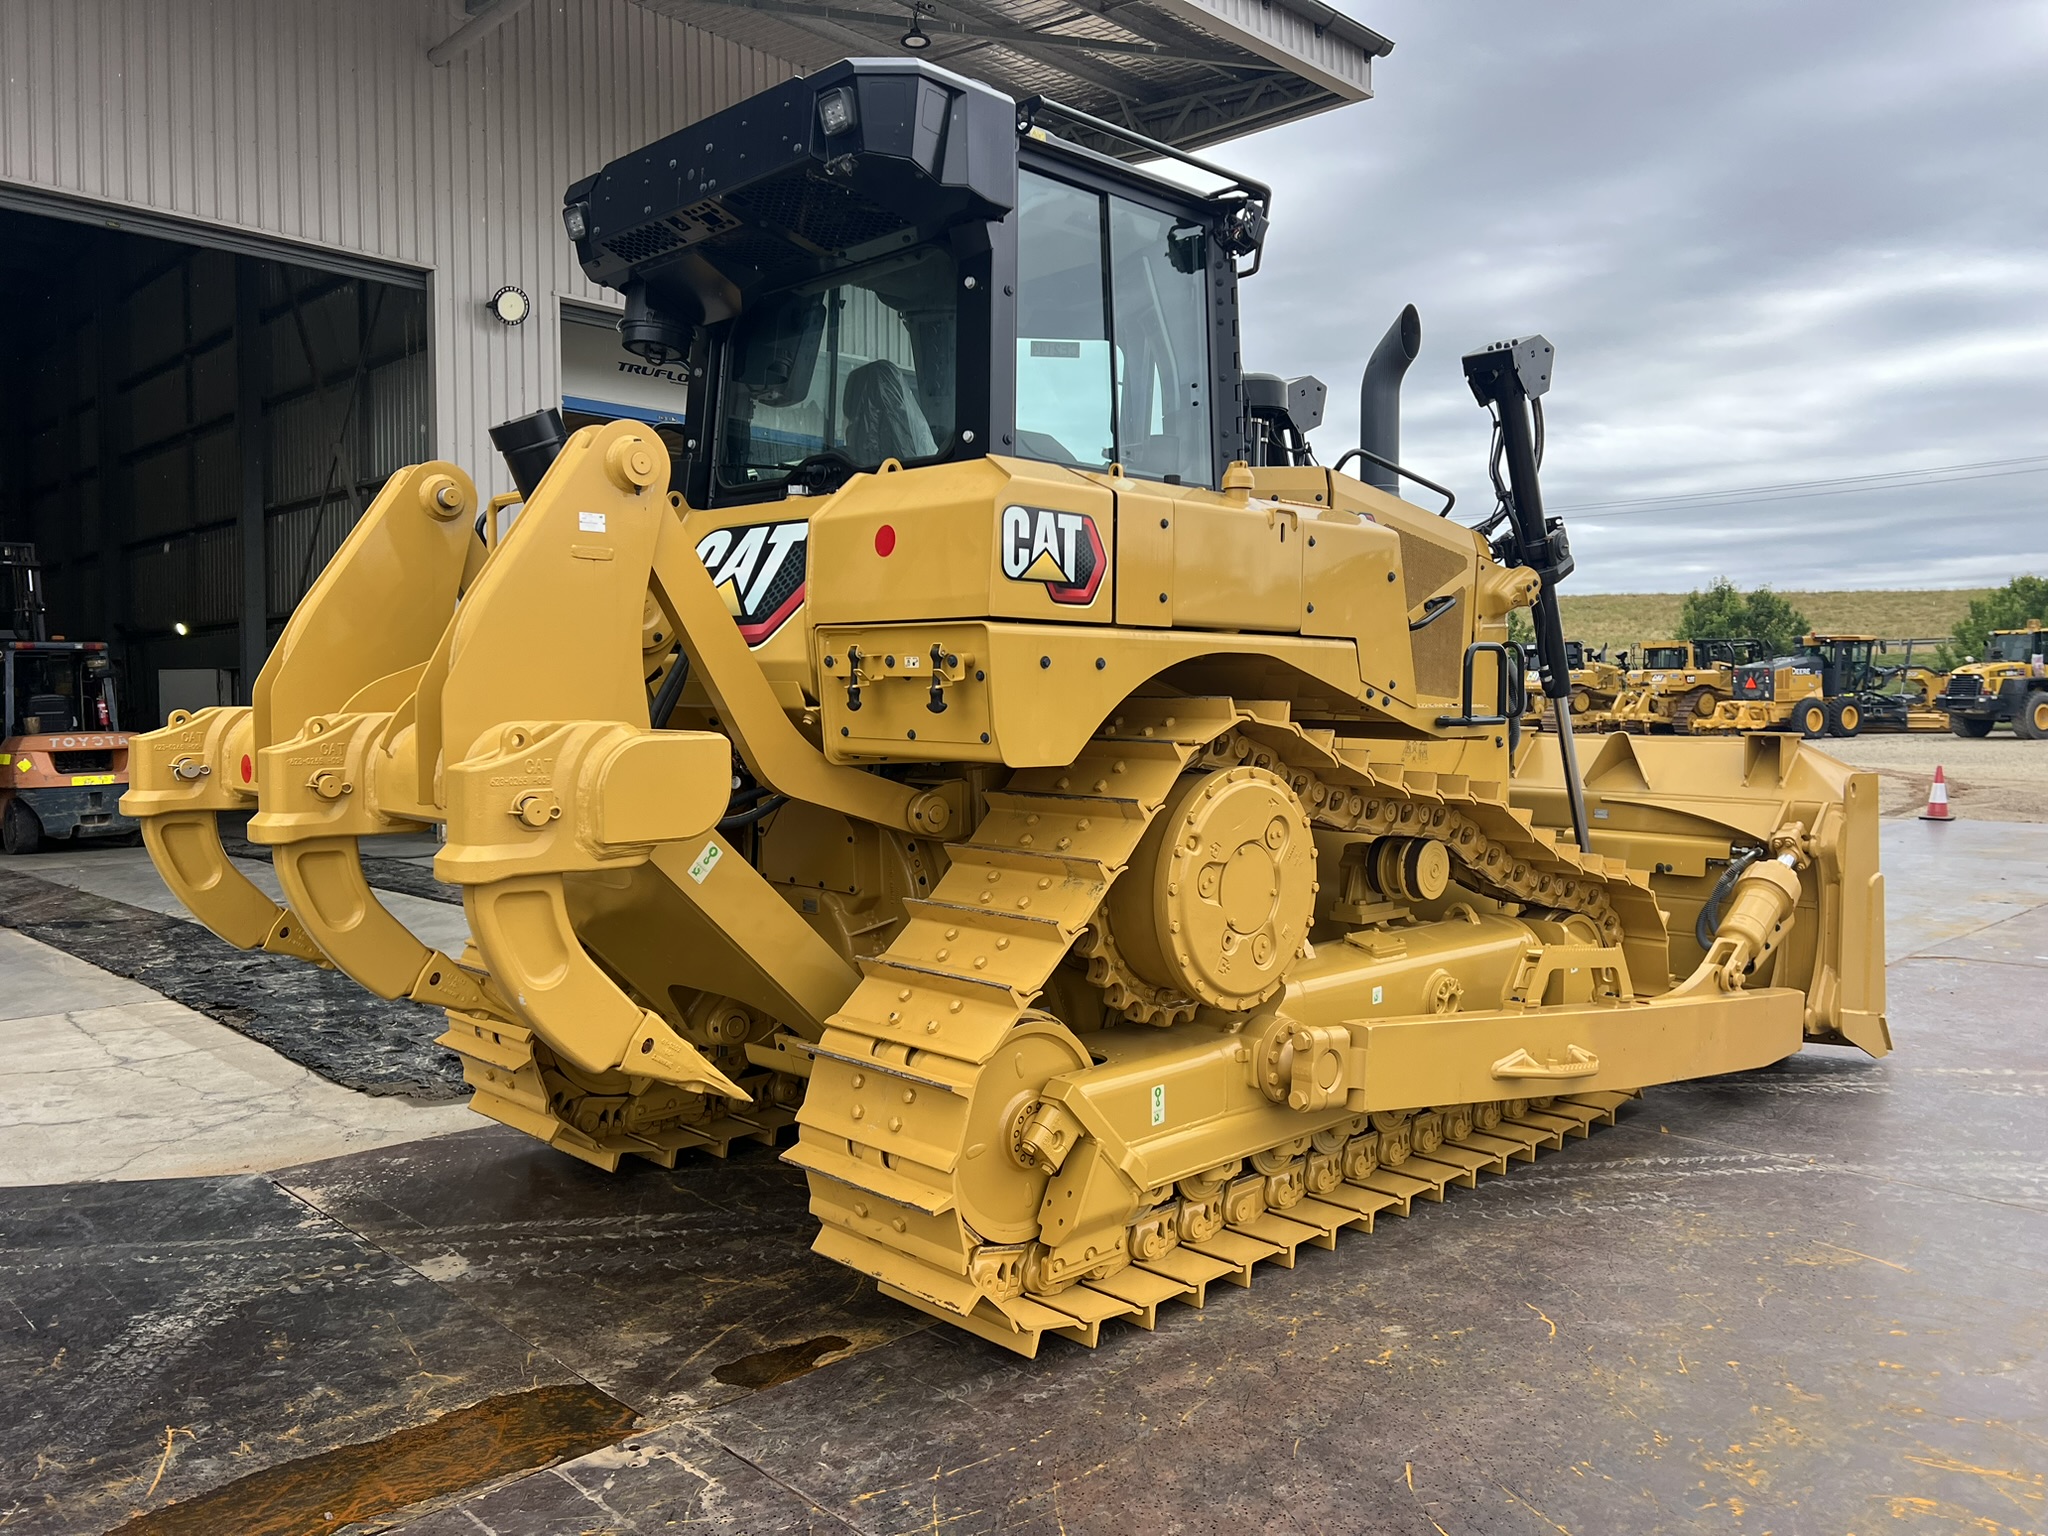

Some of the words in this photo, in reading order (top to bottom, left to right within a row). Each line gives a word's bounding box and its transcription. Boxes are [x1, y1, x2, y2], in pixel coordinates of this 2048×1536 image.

[618, 361, 689, 382] TRUFLO
[1002, 506, 1083, 583] CAT
[48, 735, 129, 748] TOYOTA
